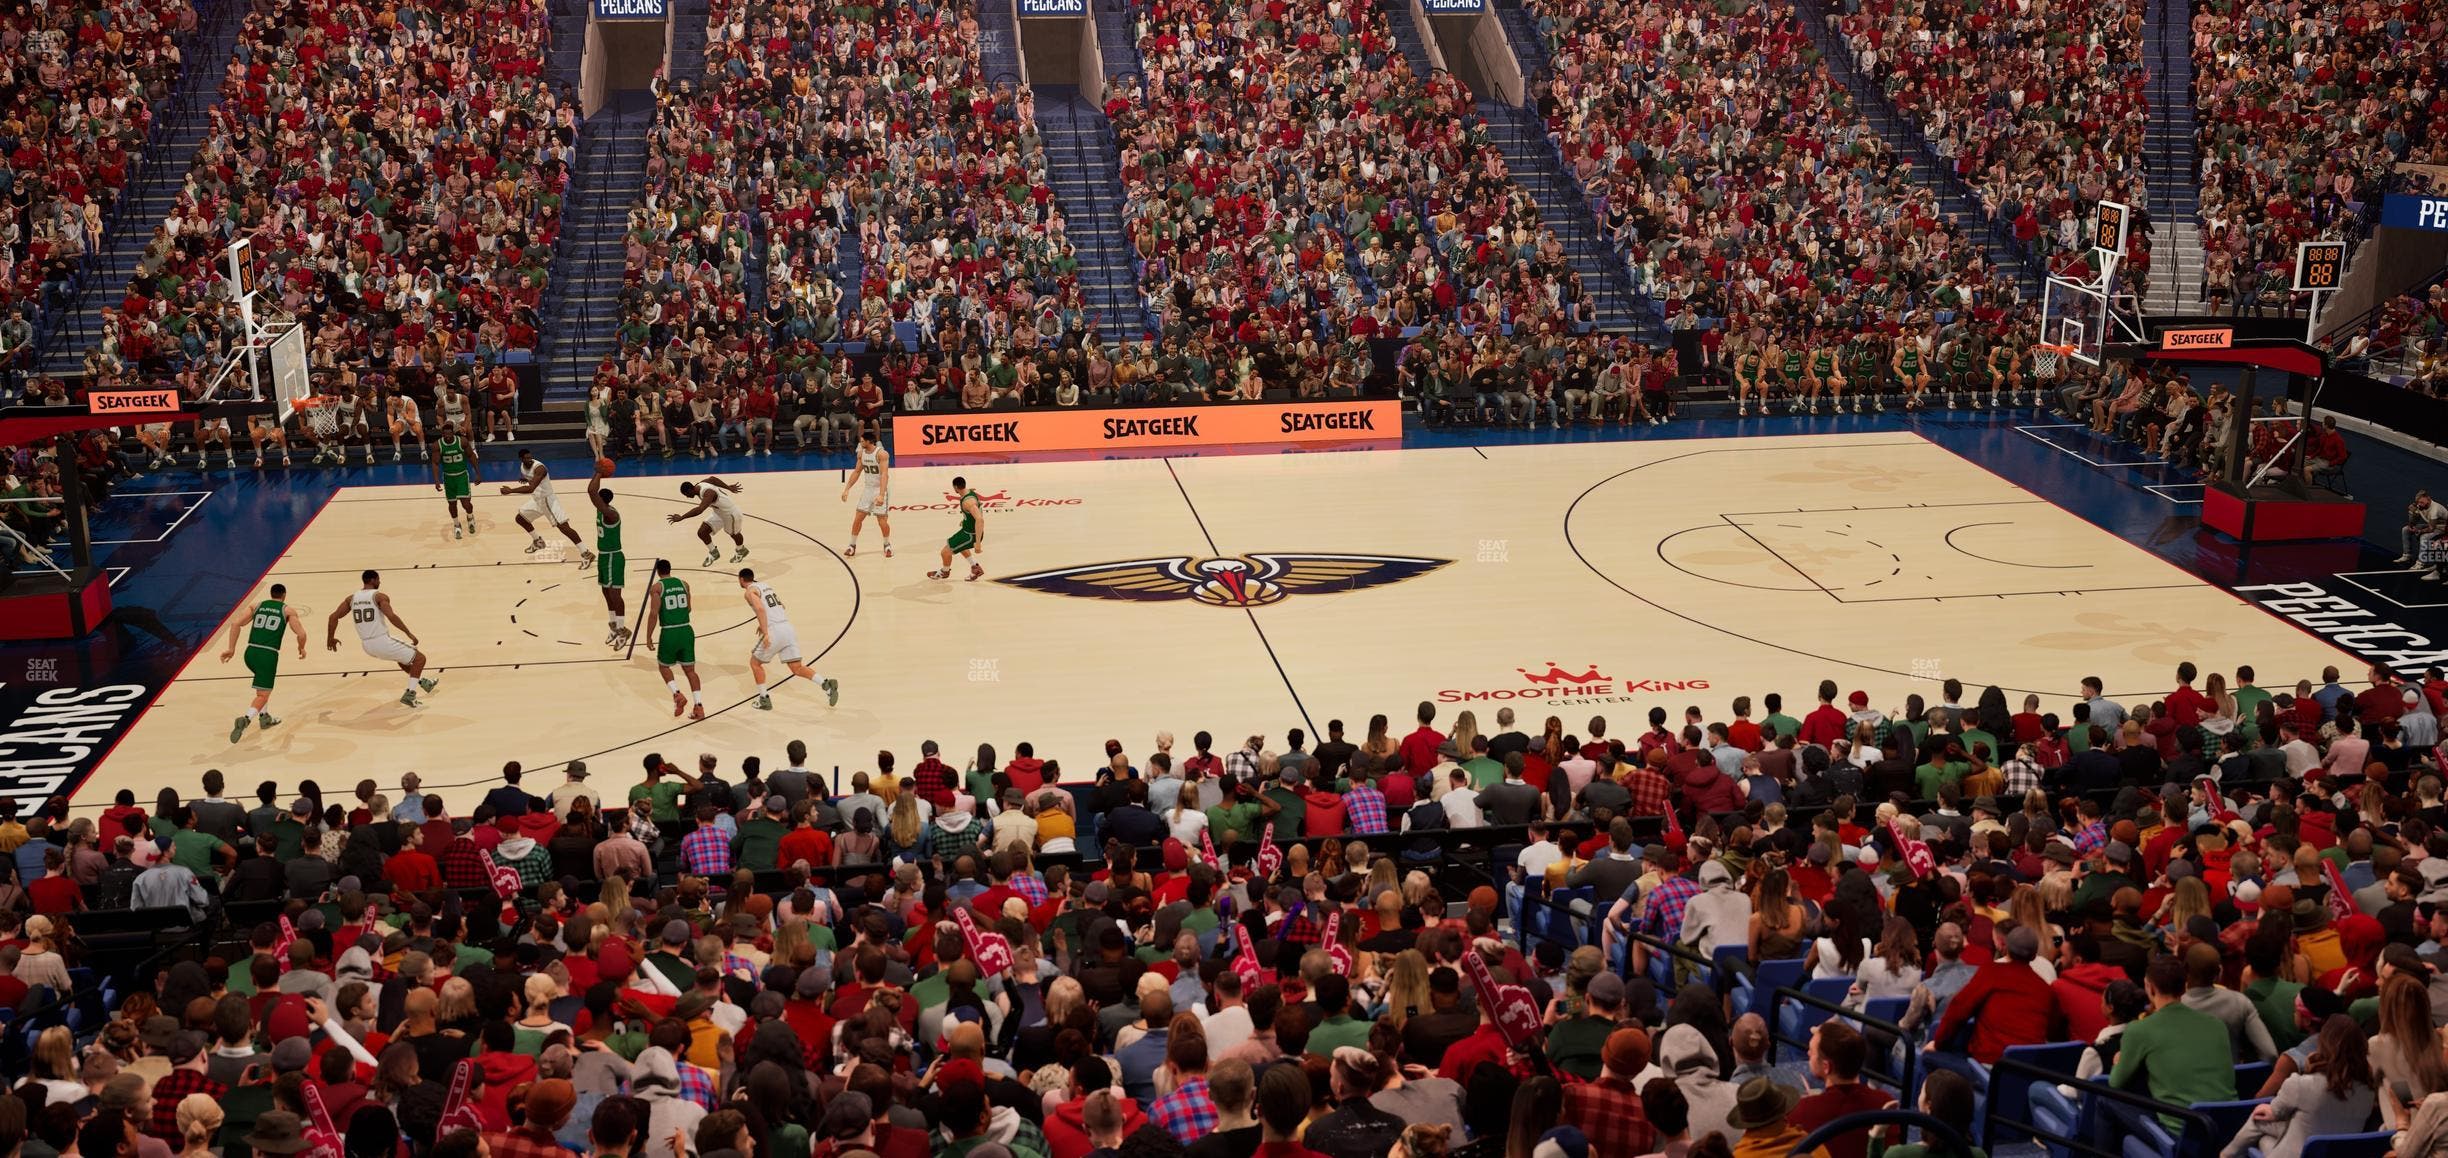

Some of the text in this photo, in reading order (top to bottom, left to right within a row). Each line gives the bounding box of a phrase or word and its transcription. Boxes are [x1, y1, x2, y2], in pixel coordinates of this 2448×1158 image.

[600, 0, 662, 15] PELICANS
[2418, 199, 2448, 229] PE
[2309, 263, 2333, 286] 88
[2171, 332, 2224, 346] SEATGEEK
[97, 393, 171, 410] SEATGEEK
[922, 408, 1375, 445] SEATGEEK SEATGEEK SEATGEEK
[664, 593, 688, 610] 00
[253, 613, 281, 632] 00
[353, 607, 375, 624] 00
[1437, 684, 1614, 703] SMOOTHIE
[1547, 695, 1634, 707] CENTER
